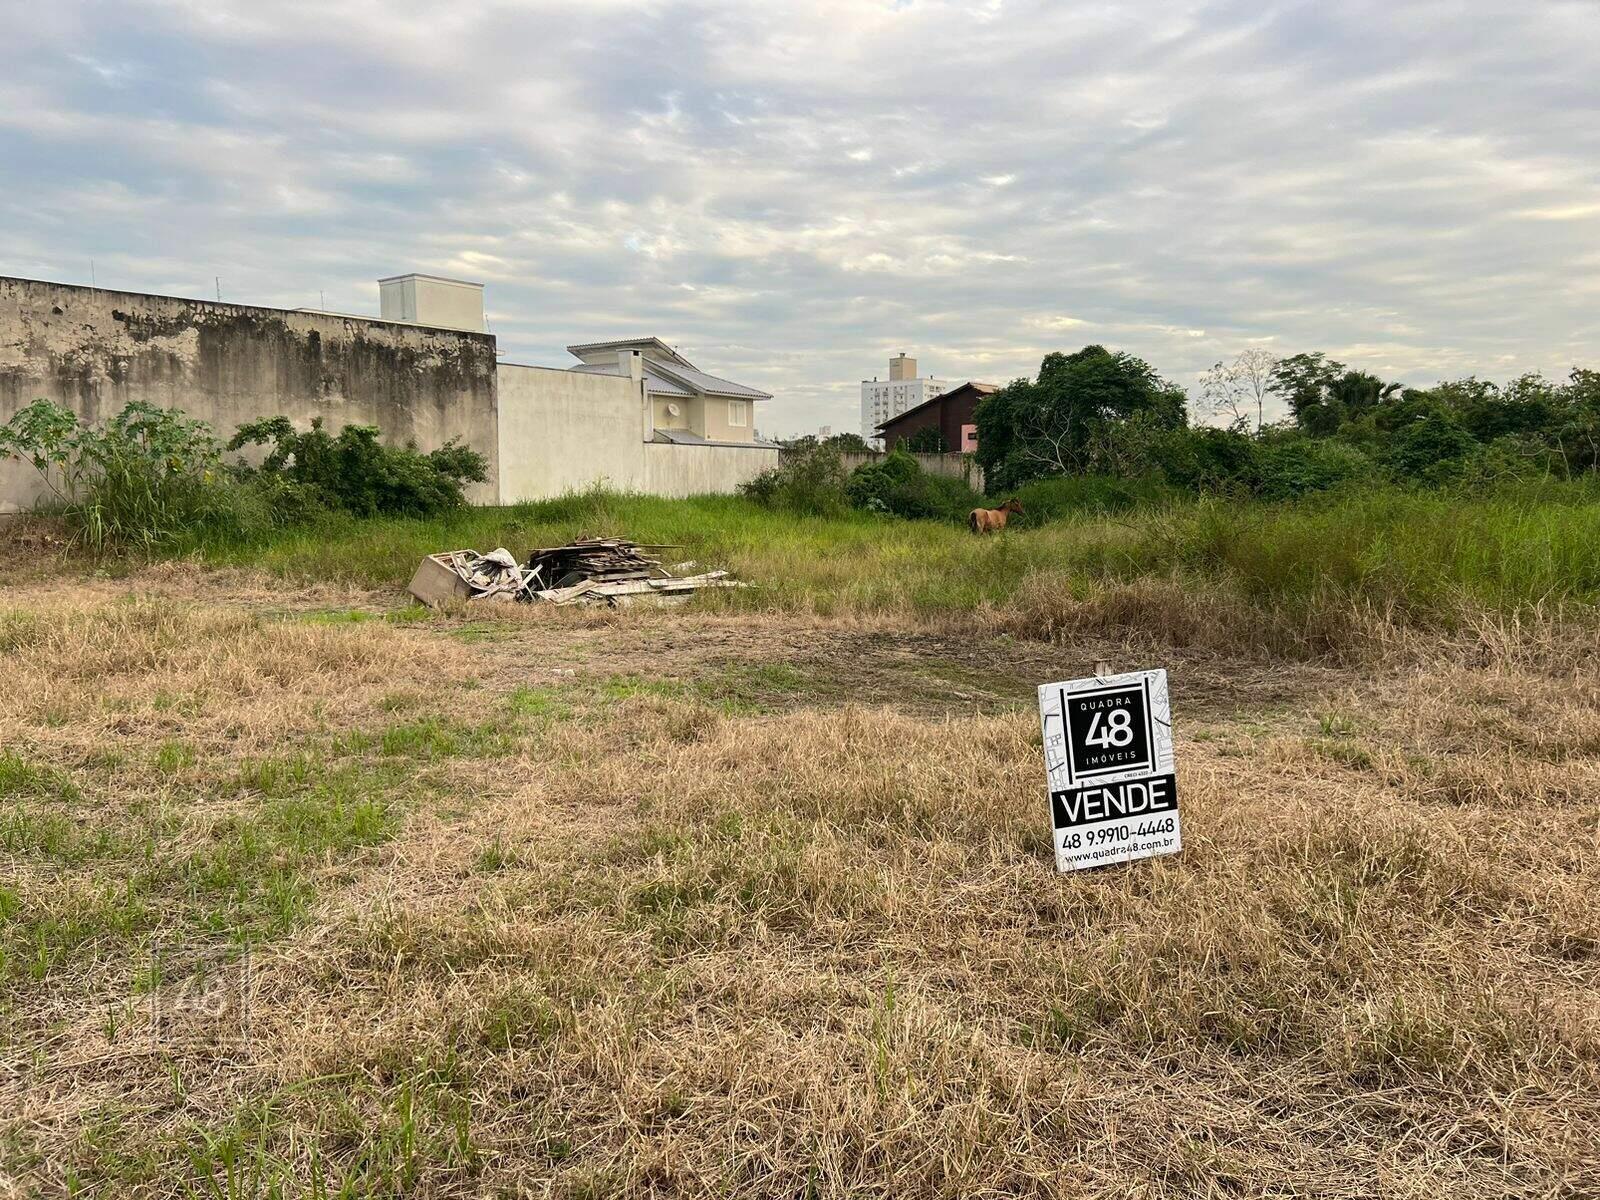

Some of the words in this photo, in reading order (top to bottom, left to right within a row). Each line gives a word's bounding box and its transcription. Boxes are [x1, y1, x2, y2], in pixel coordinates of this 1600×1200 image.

[1080, 697, 1131, 711] QUADRA
[1085, 708, 1134, 749] 48
[1086, 750, 1137, 765] IMÓVEIS
[1060, 779, 1169, 822] VENDE
[1062, 833, 1082, 850] 48
[1086, 817, 1175, 847] 9.9910-4448
[1065, 838, 1174, 863] www.quadra48.com.br
